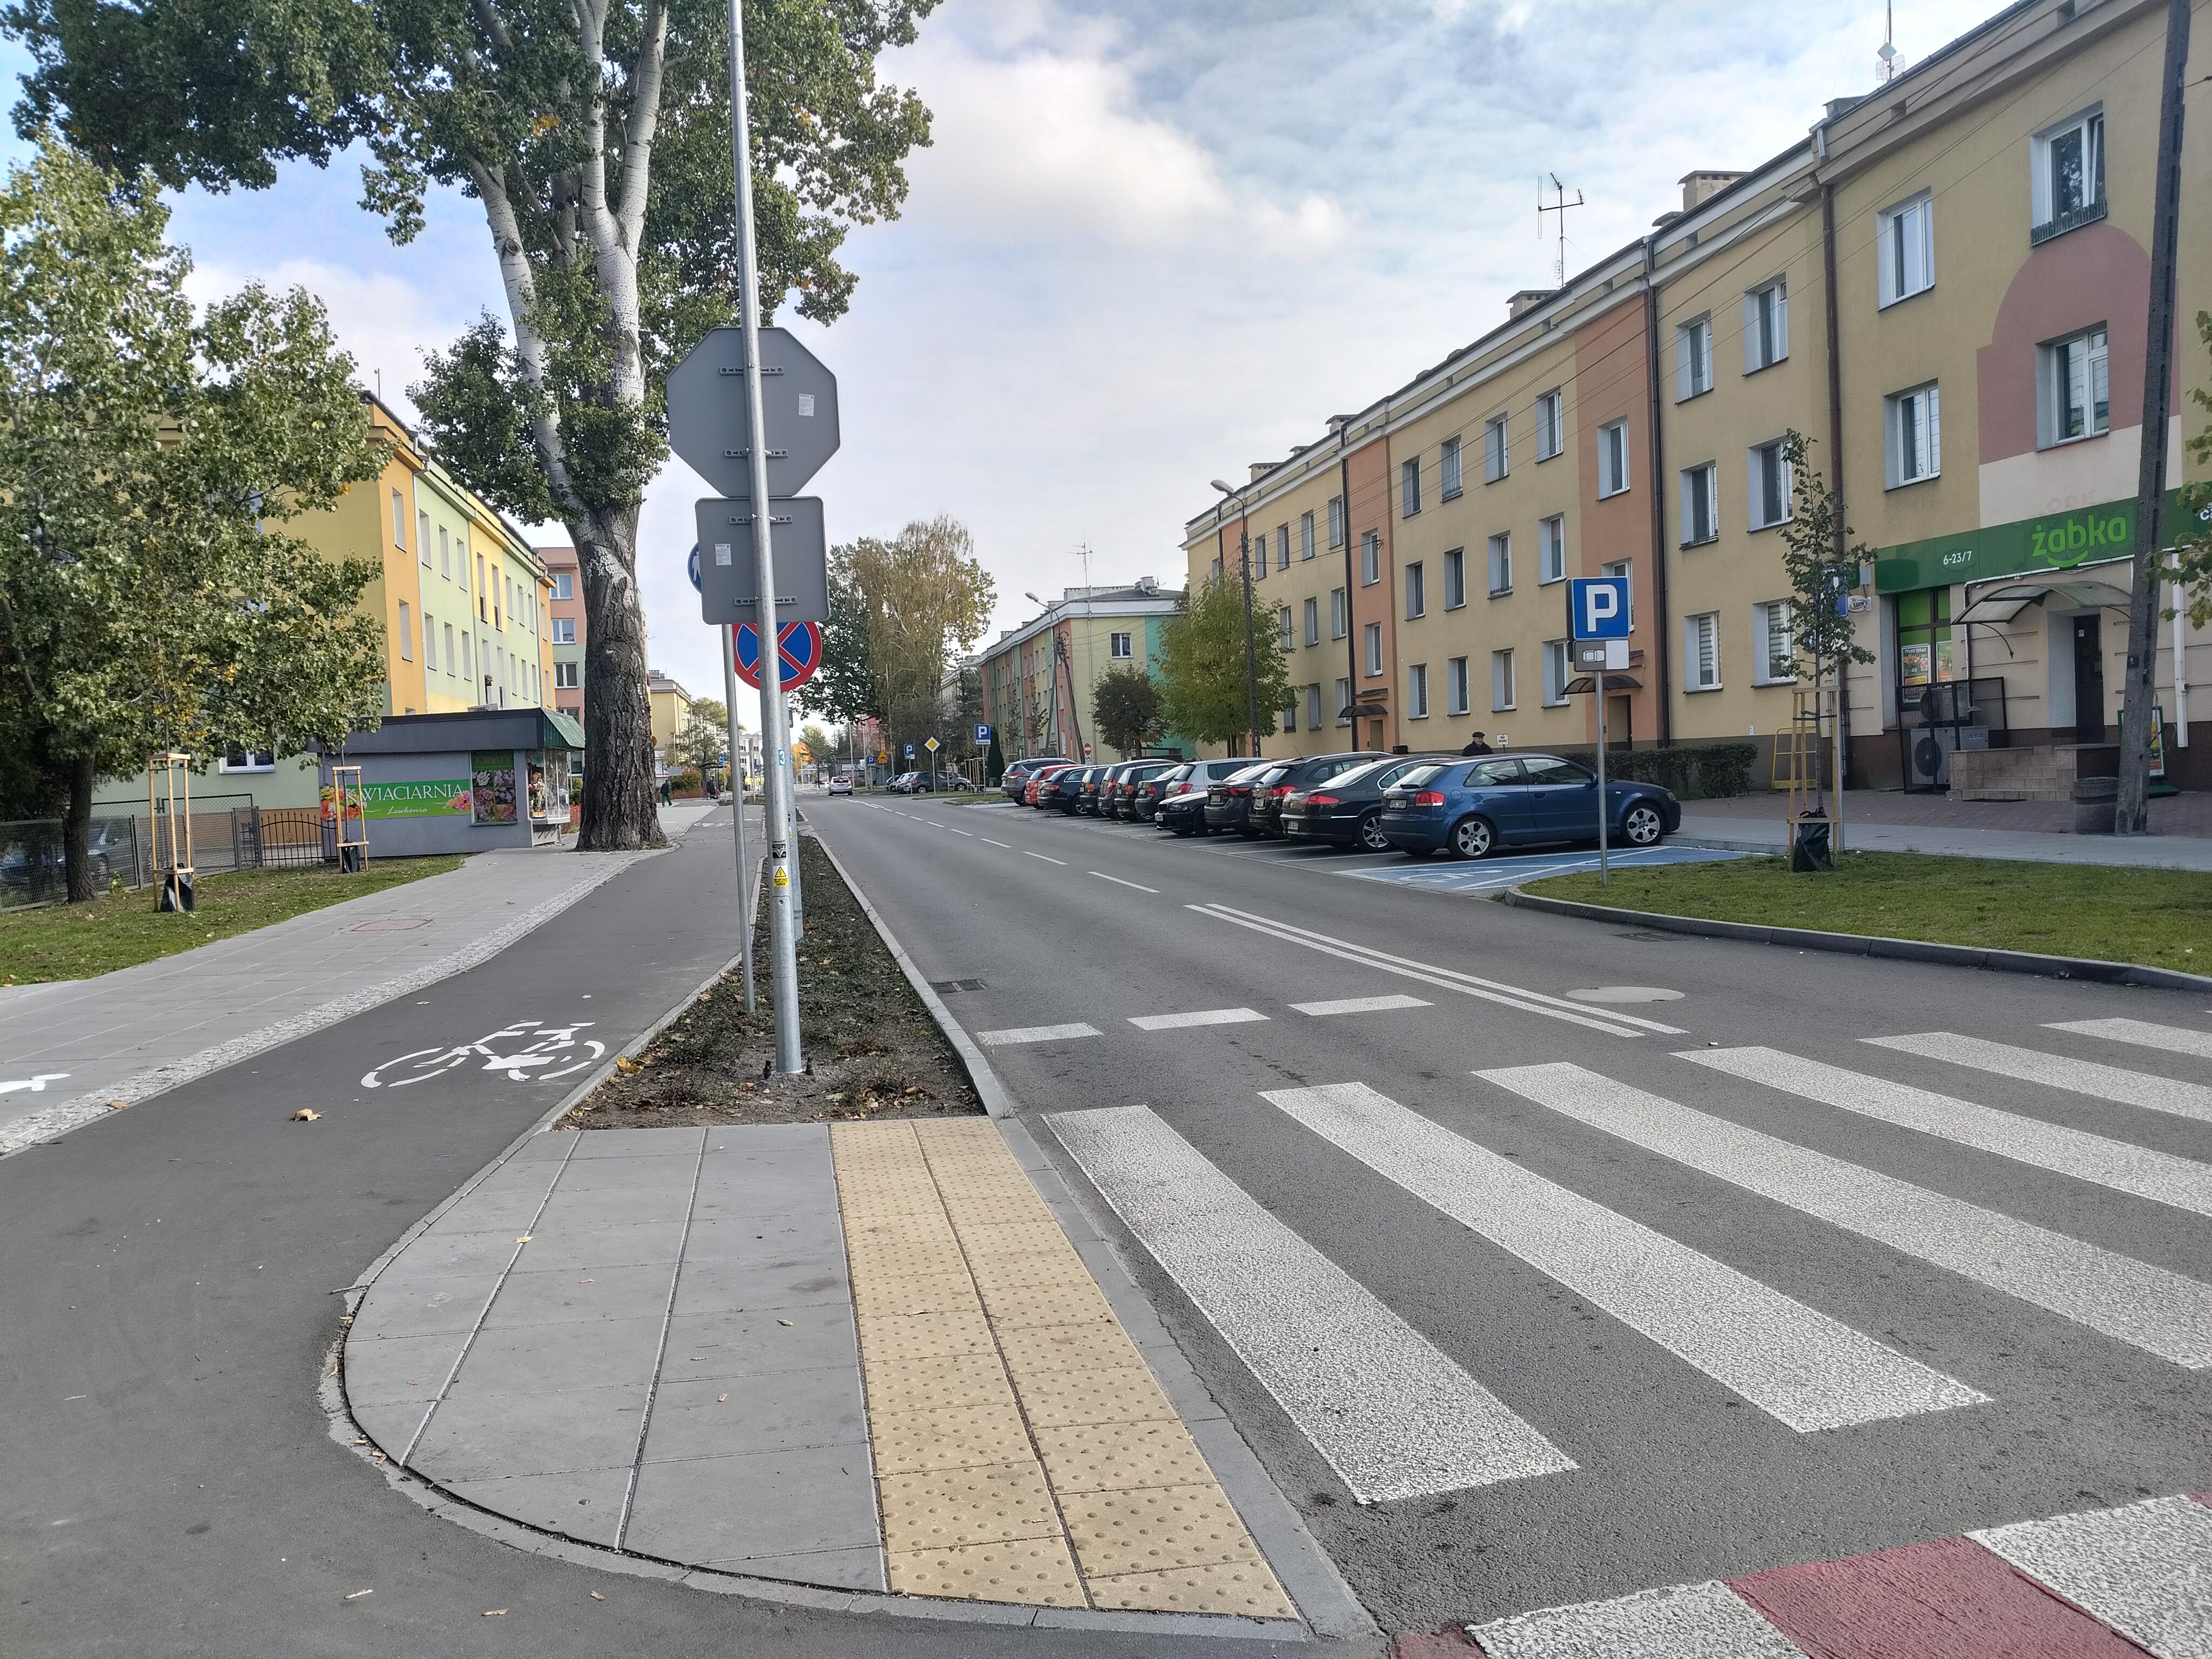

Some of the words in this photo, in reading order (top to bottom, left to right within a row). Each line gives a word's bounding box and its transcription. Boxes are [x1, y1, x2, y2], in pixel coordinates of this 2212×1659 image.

[2032, 515, 2127, 557] żabka
[1943, 550, 1972, 565] 6-23/7
[1586, 584, 1618, 632] P
[978, 726, 987, 738] P
[906, 745, 913, 753] P
[475, 755, 510, 764] KWIATY
[779, 751, 785, 765] 3
[346, 784, 464, 802] KWIACIARNIA
[387, 806, 428, 815] Lewkonia
